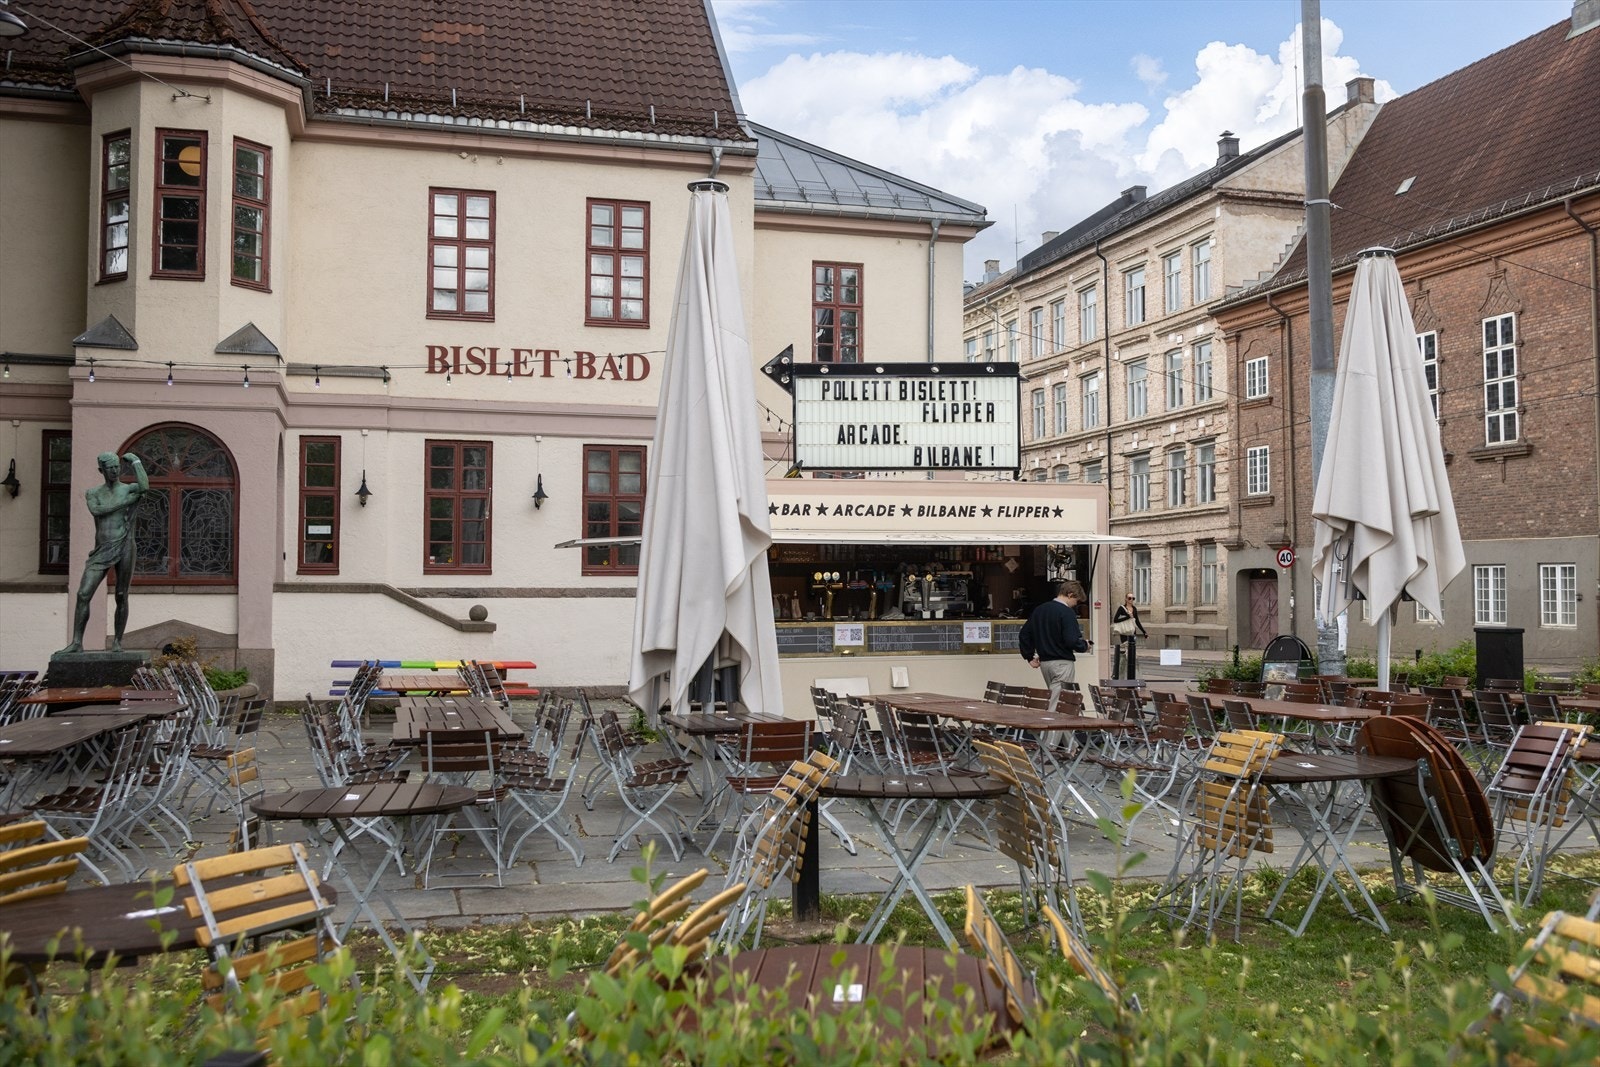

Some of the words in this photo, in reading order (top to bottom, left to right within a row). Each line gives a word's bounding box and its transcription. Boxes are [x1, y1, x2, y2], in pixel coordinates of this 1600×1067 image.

[425, 345, 560, 378] BISLET
[573, 351, 651, 382] BAD
[821, 380, 891, 401] POLLETT
[899, 380, 977, 401] BISLETT!
[922, 402, 995, 423] FLIPPER
[781, 503, 811, 516] BAR
[832, 504, 896, 517] ARCADE
[917, 505, 977, 518] BILBANE
[997, 506, 1050, 518] FLIPPER
[1280, 552, 1292, 562] 40
